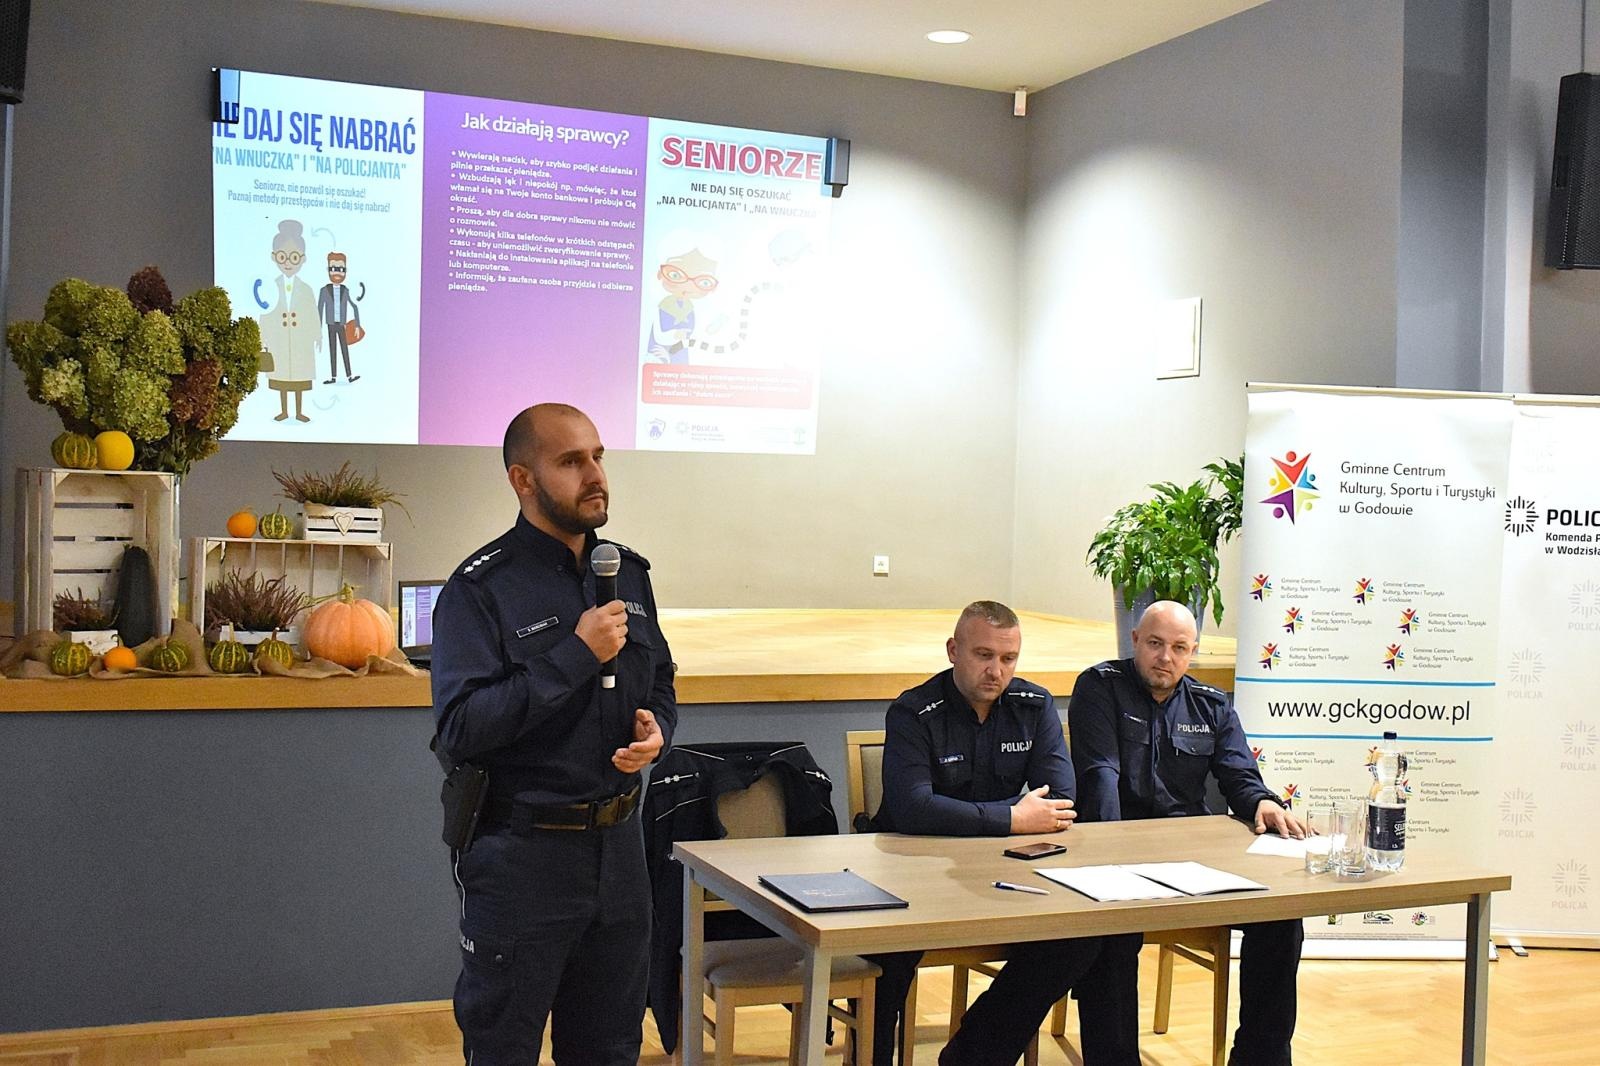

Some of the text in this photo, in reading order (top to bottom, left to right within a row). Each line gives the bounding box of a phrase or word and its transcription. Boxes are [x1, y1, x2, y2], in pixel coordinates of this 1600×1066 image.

[244, 106, 282, 142] DAJ
[290, 112, 323, 153] SIĘ
[330, 117, 416, 155] NABRAĆ
[460, 111, 629, 150] Jak działają sprawcy?
[235, 148, 300, 171] WNUCZKA"
[335, 158, 407, 180] POLICJANTA"
[662, 137, 822, 180] SENIORZE
[254, 179, 287, 193] Seniorze,
[690, 182, 792, 201] NIE DAJ SIĘ OSZUKAĆ
[228, 190, 251, 205] Poznaj
[253, 192, 279, 207] metody
[1340, 461, 1445, 477] Gminne Centrum
[1340, 481, 1496, 501] Kultury, Sportu i Turystyki
[1339, 502, 1413, 516] w Godowie
[1545, 532, 1592, 542] Komenda
[1507, 690, 1543, 699] POLICJA
[1267, 698, 1470, 725] www.gckgodow.pl
[1177, 723, 1210, 733] POLICJA
[1560, 762, 1597, 771] POLICJA
[1498, 829, 1534, 839] POLICJA
[1551, 901, 1588, 910] POLICJA
